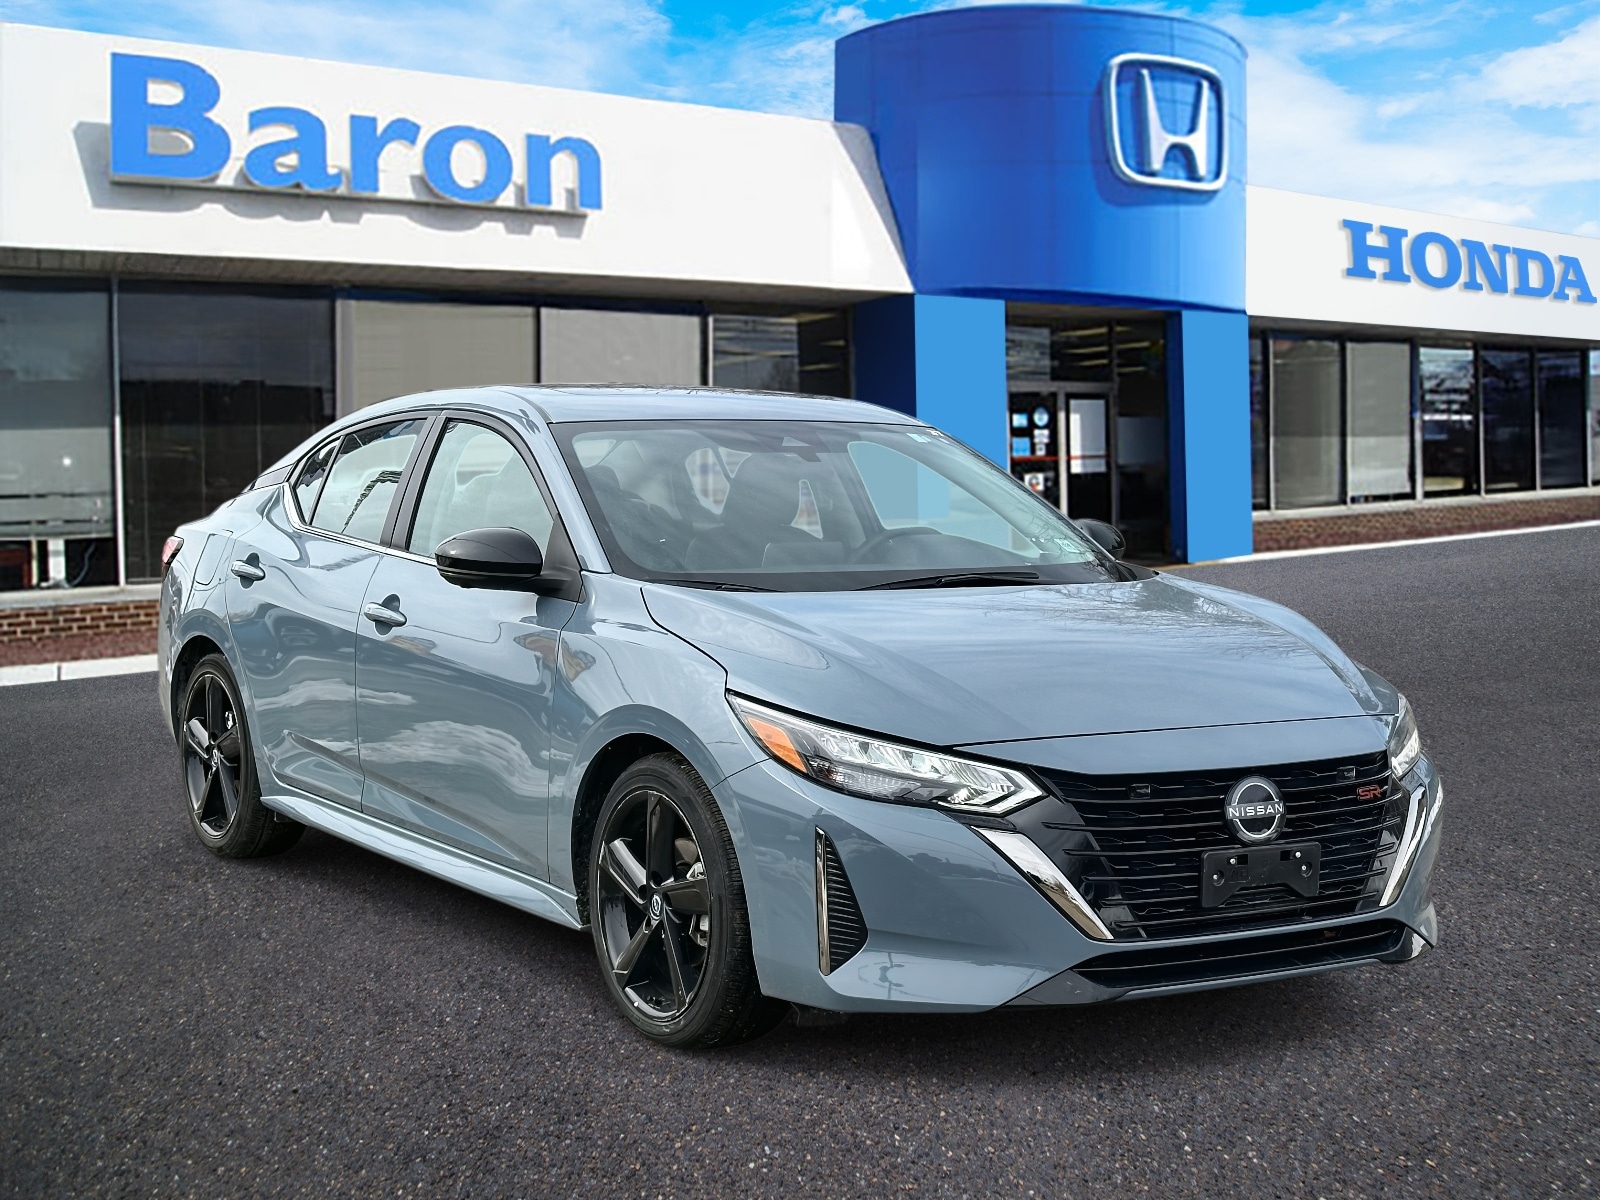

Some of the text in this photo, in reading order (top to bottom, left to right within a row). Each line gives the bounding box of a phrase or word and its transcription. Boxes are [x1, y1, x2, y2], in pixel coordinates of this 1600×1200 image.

[110, 52, 602, 210] Baron
[1343, 219, 1598, 304] HONDA
[1229, 803, 1284, 817] NISSAN
[1357, 785, 1381, 800] SR
